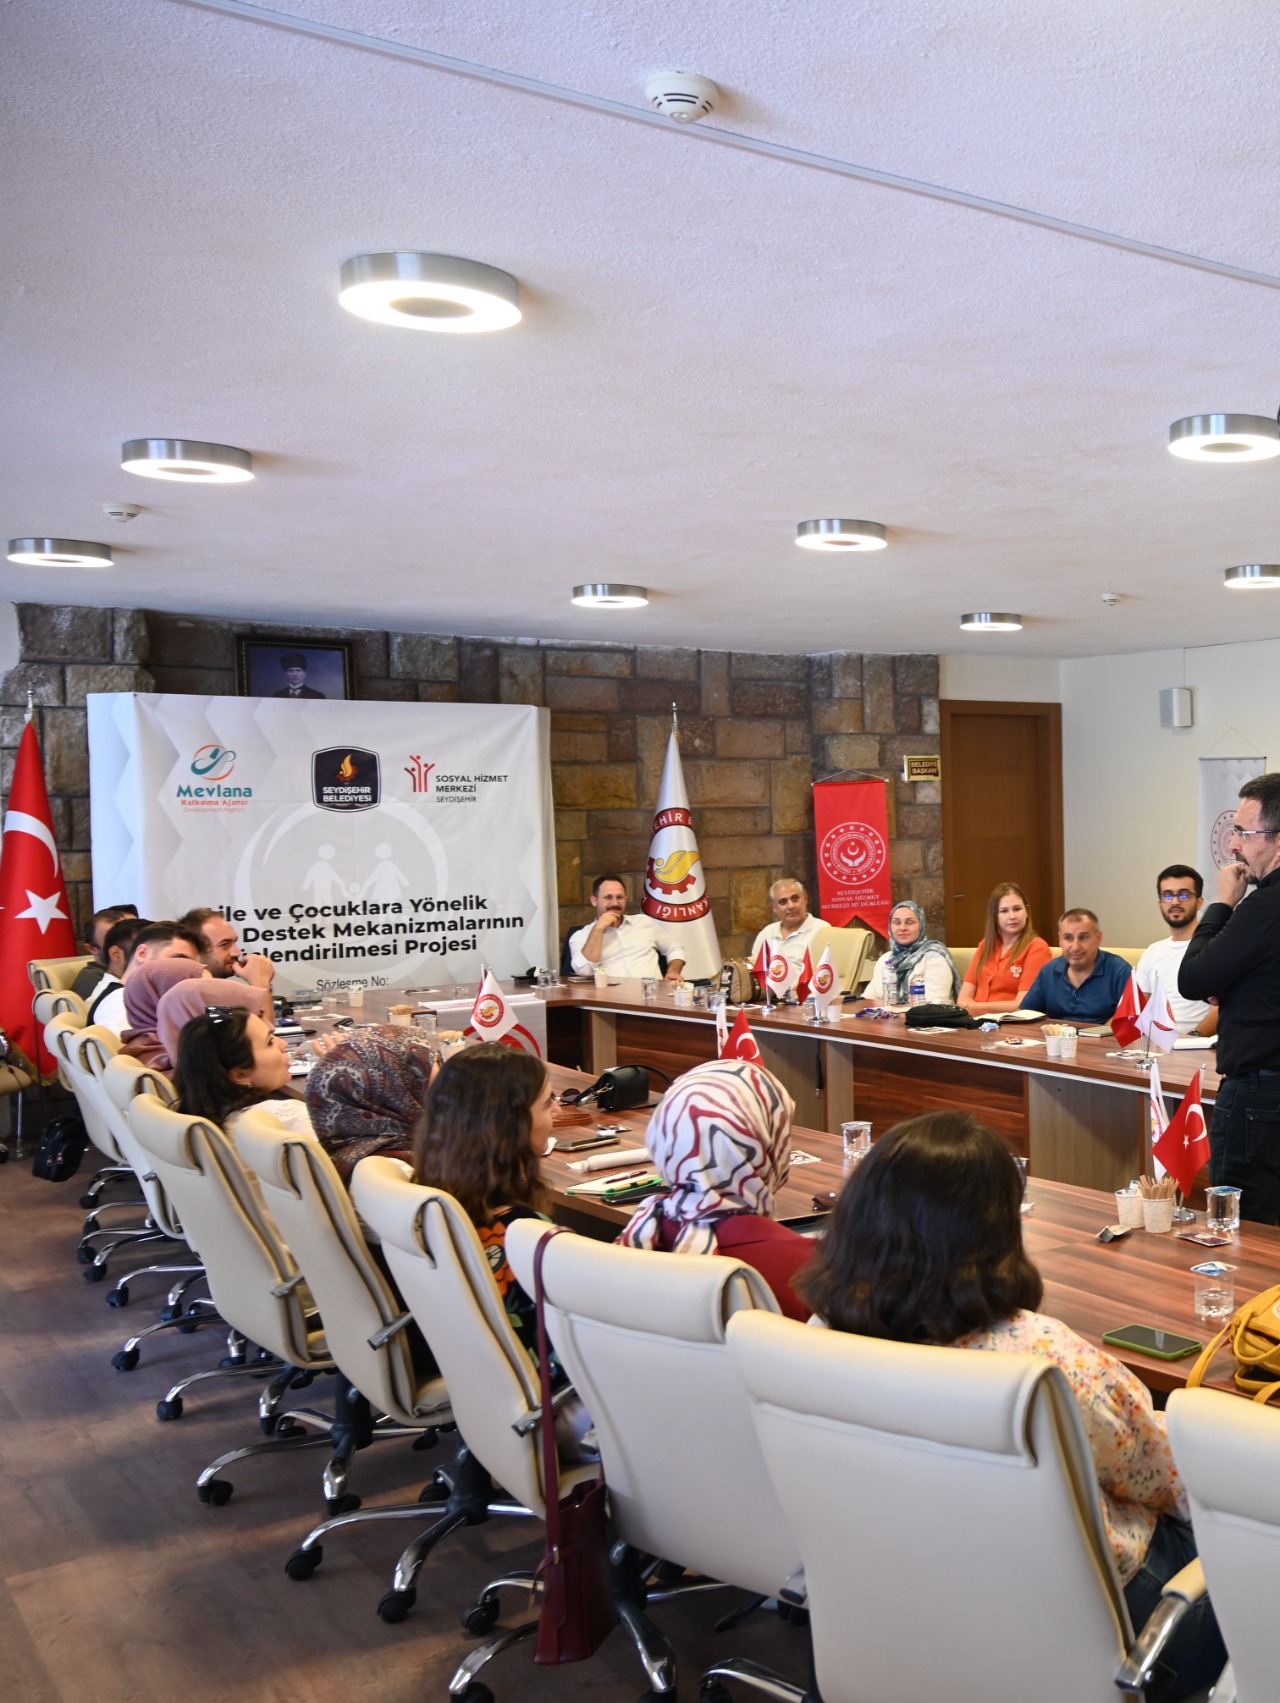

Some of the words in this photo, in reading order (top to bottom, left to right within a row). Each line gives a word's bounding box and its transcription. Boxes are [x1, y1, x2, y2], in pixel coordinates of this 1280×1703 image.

[435, 774, 472, 783] SOSYAL
[474, 773, 509, 783] HİZMET
[176, 784, 253, 798] Mevlana
[435, 784, 477, 793] MERKEZİ
[222, 799, 248, 807] Ajansı
[436, 795, 477, 804] SEYDİŞEHİR
[218, 904, 248, 923] ile
[253, 907, 282, 921] ve
[288, 900, 403, 924] Çocuklara
[409, 894, 488, 914] Yönelik
[242, 923, 327, 944] Destek
[333, 915, 525, 938] Mekanizmalarının
[404, 934, 478, 957] Projesi
[371, 975, 390, 987] No:
